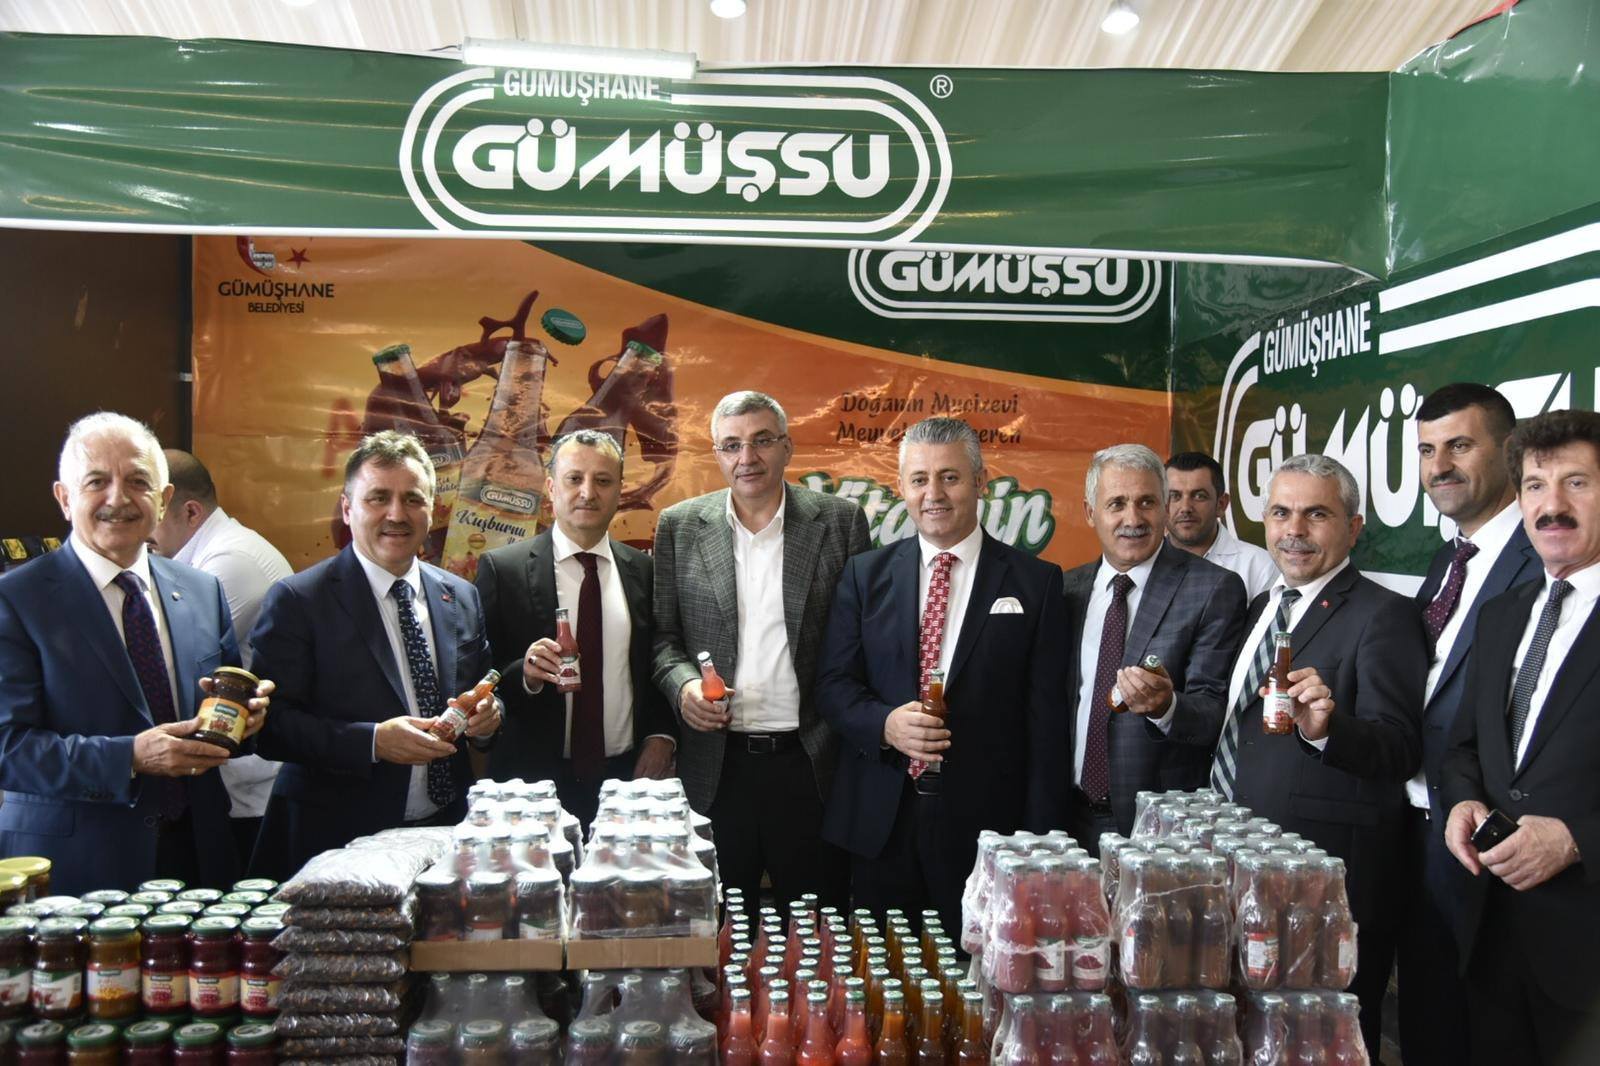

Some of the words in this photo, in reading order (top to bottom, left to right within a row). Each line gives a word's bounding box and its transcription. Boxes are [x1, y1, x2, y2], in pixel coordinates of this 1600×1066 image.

[452, 118, 890, 203] GÜMÜŞSU
[218, 279, 335, 301] GÜMÜŞHANE
[878, 250, 1129, 298] GÜMÜŞSU
[248, 301, 305, 314] BELEDİYESİ
[1263, 301, 1371, 378] GÜMÜŞHANE
[1237, 366, 1600, 543] GÜMÜ
